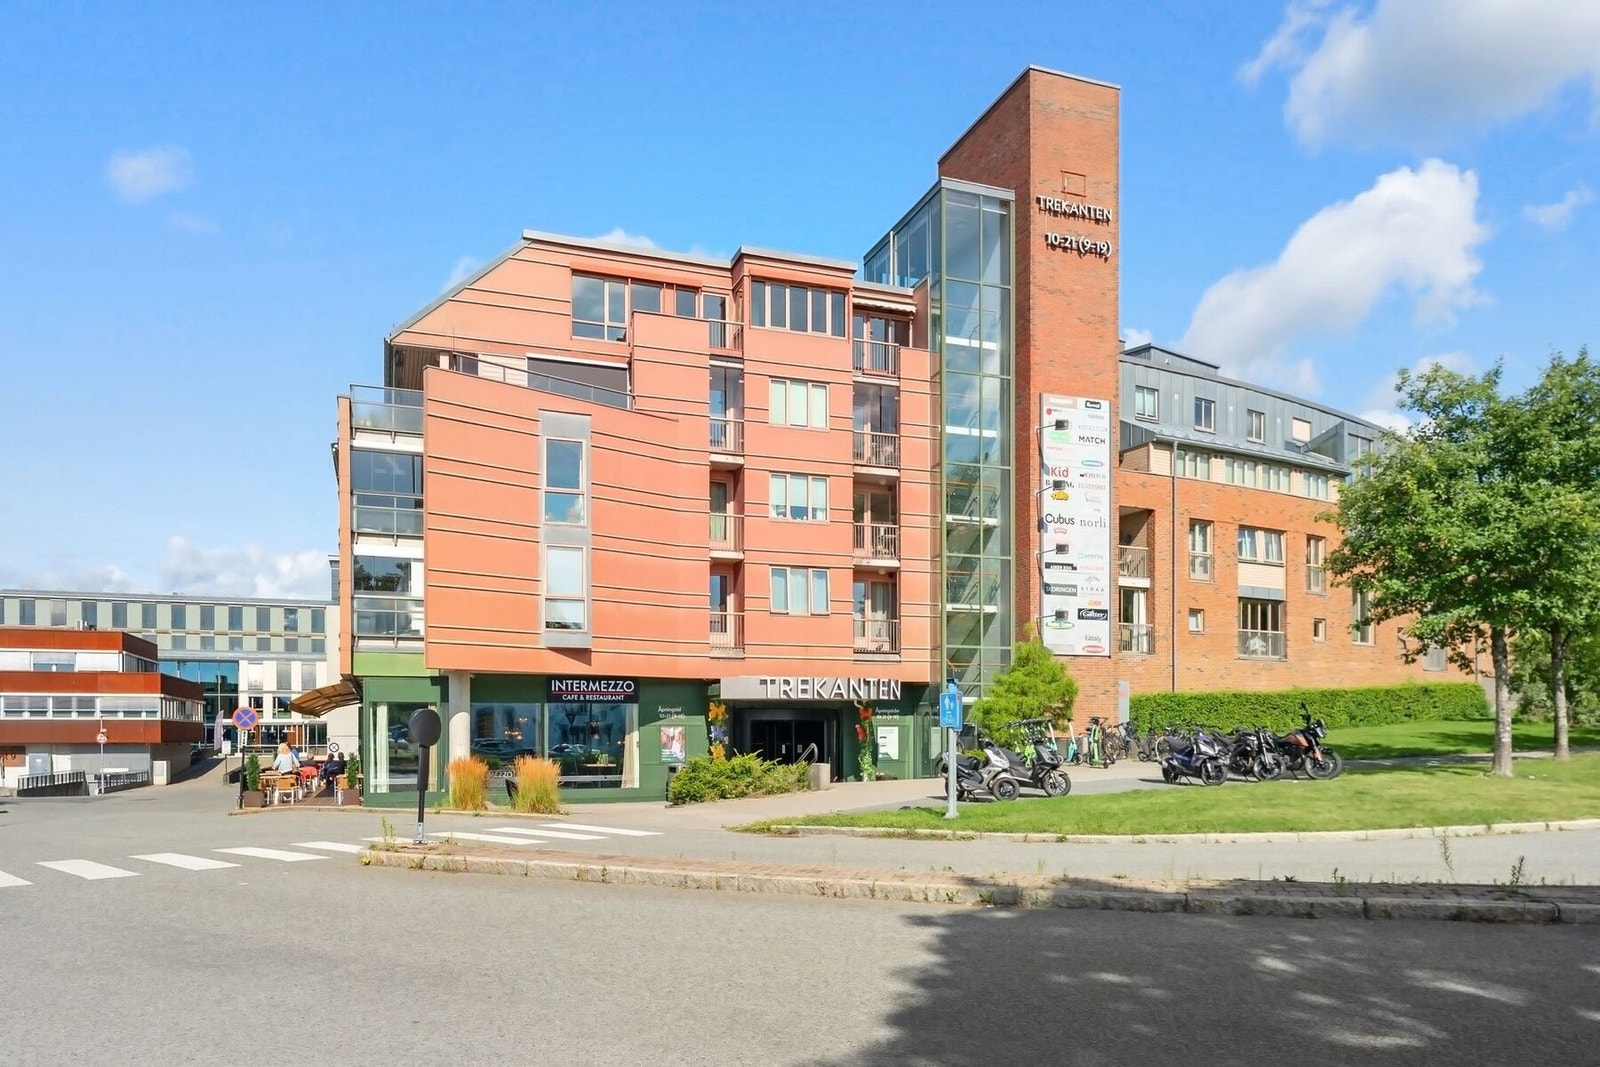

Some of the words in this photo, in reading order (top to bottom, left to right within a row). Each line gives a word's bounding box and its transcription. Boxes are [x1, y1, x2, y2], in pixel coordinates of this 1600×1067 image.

[1037, 195, 1112, 220] TREKANTEN
[1046, 232, 1076, 248] 10-21
[1079, 236, 1112, 257] (9-19)
[1078, 435, 1106, 445] MATCH
[1050, 467, 1069, 478] Kid
[1045, 513, 1075, 525] Cubus
[1080, 516, 1107, 529] norli
[551, 679, 635, 692] INTERMEZZO
[760, 677, 900, 700] TREKANTEN
